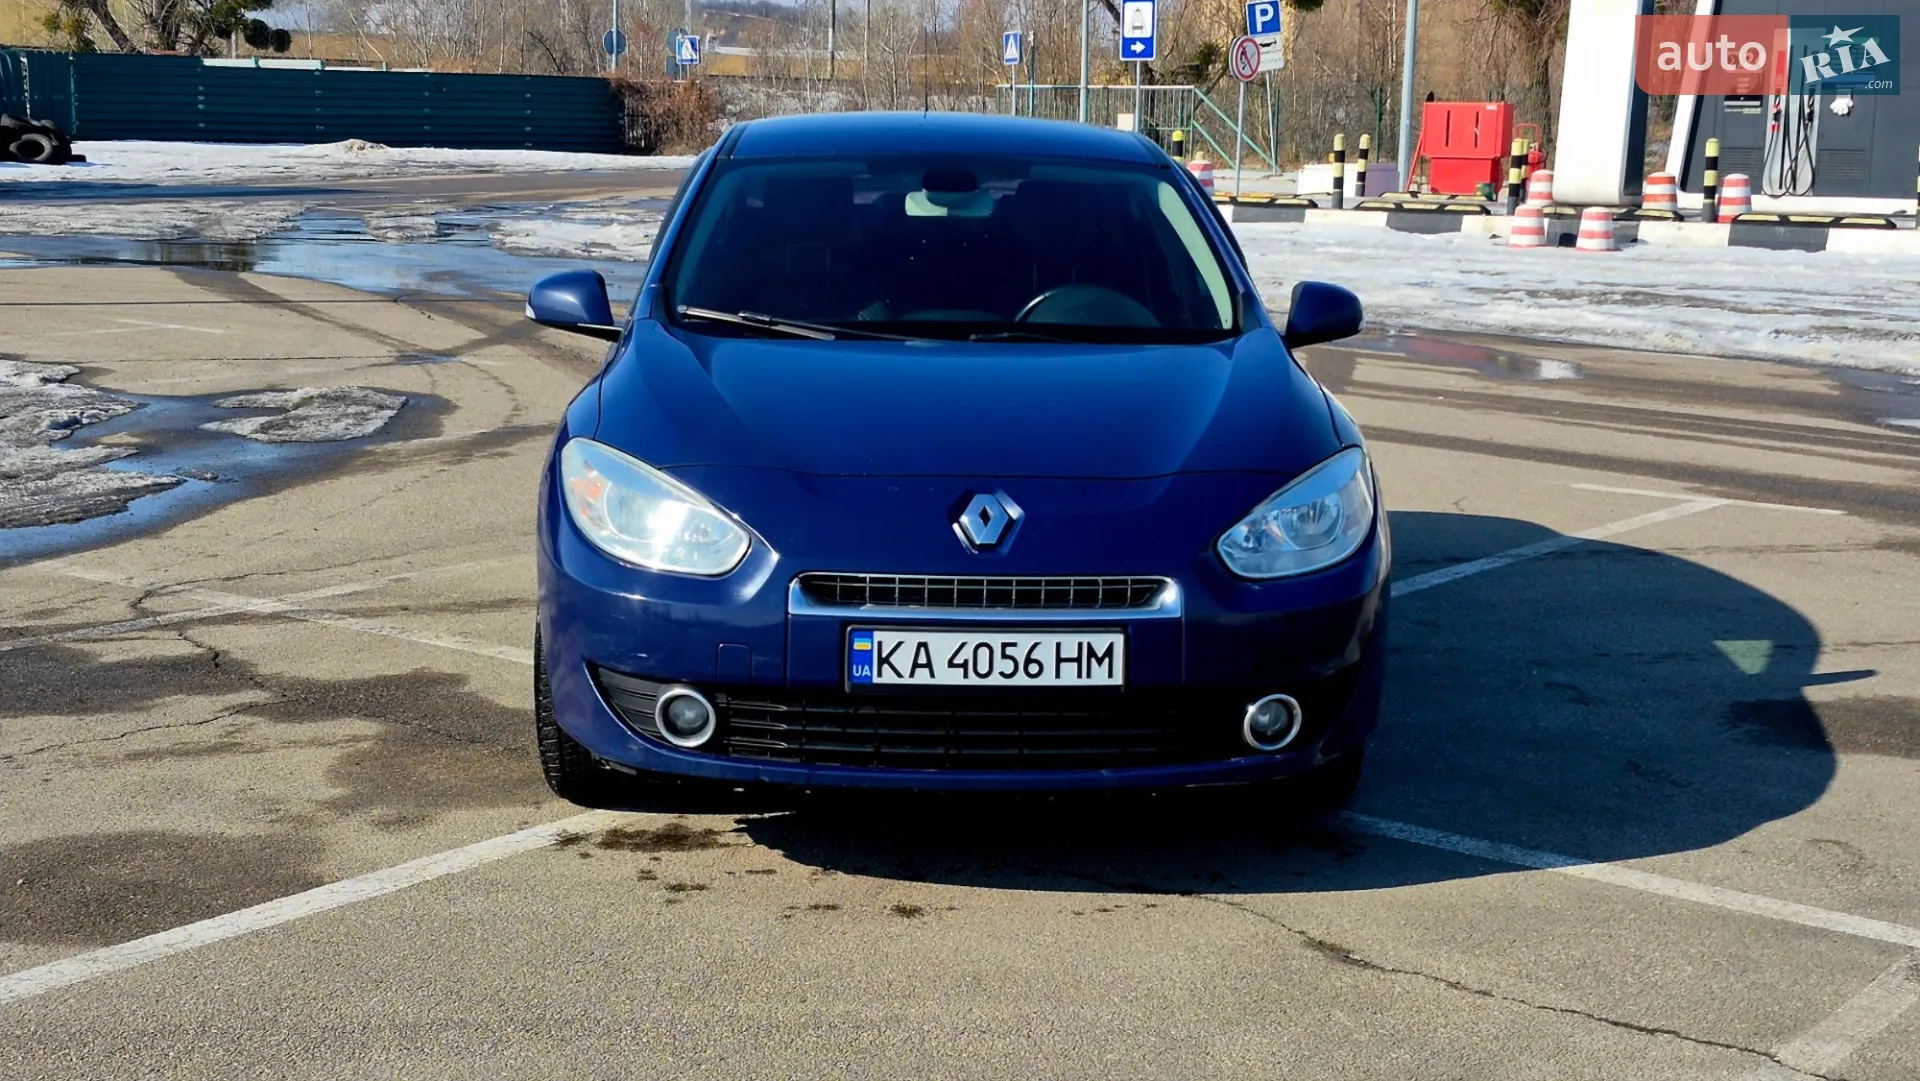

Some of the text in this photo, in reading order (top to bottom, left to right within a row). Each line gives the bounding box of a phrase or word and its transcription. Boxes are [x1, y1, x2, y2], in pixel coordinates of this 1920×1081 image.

[1254, 3, 1274, 33] P
[853, 665, 871, 677] UA
[876, 640, 1114, 680] KA 4056 HM
